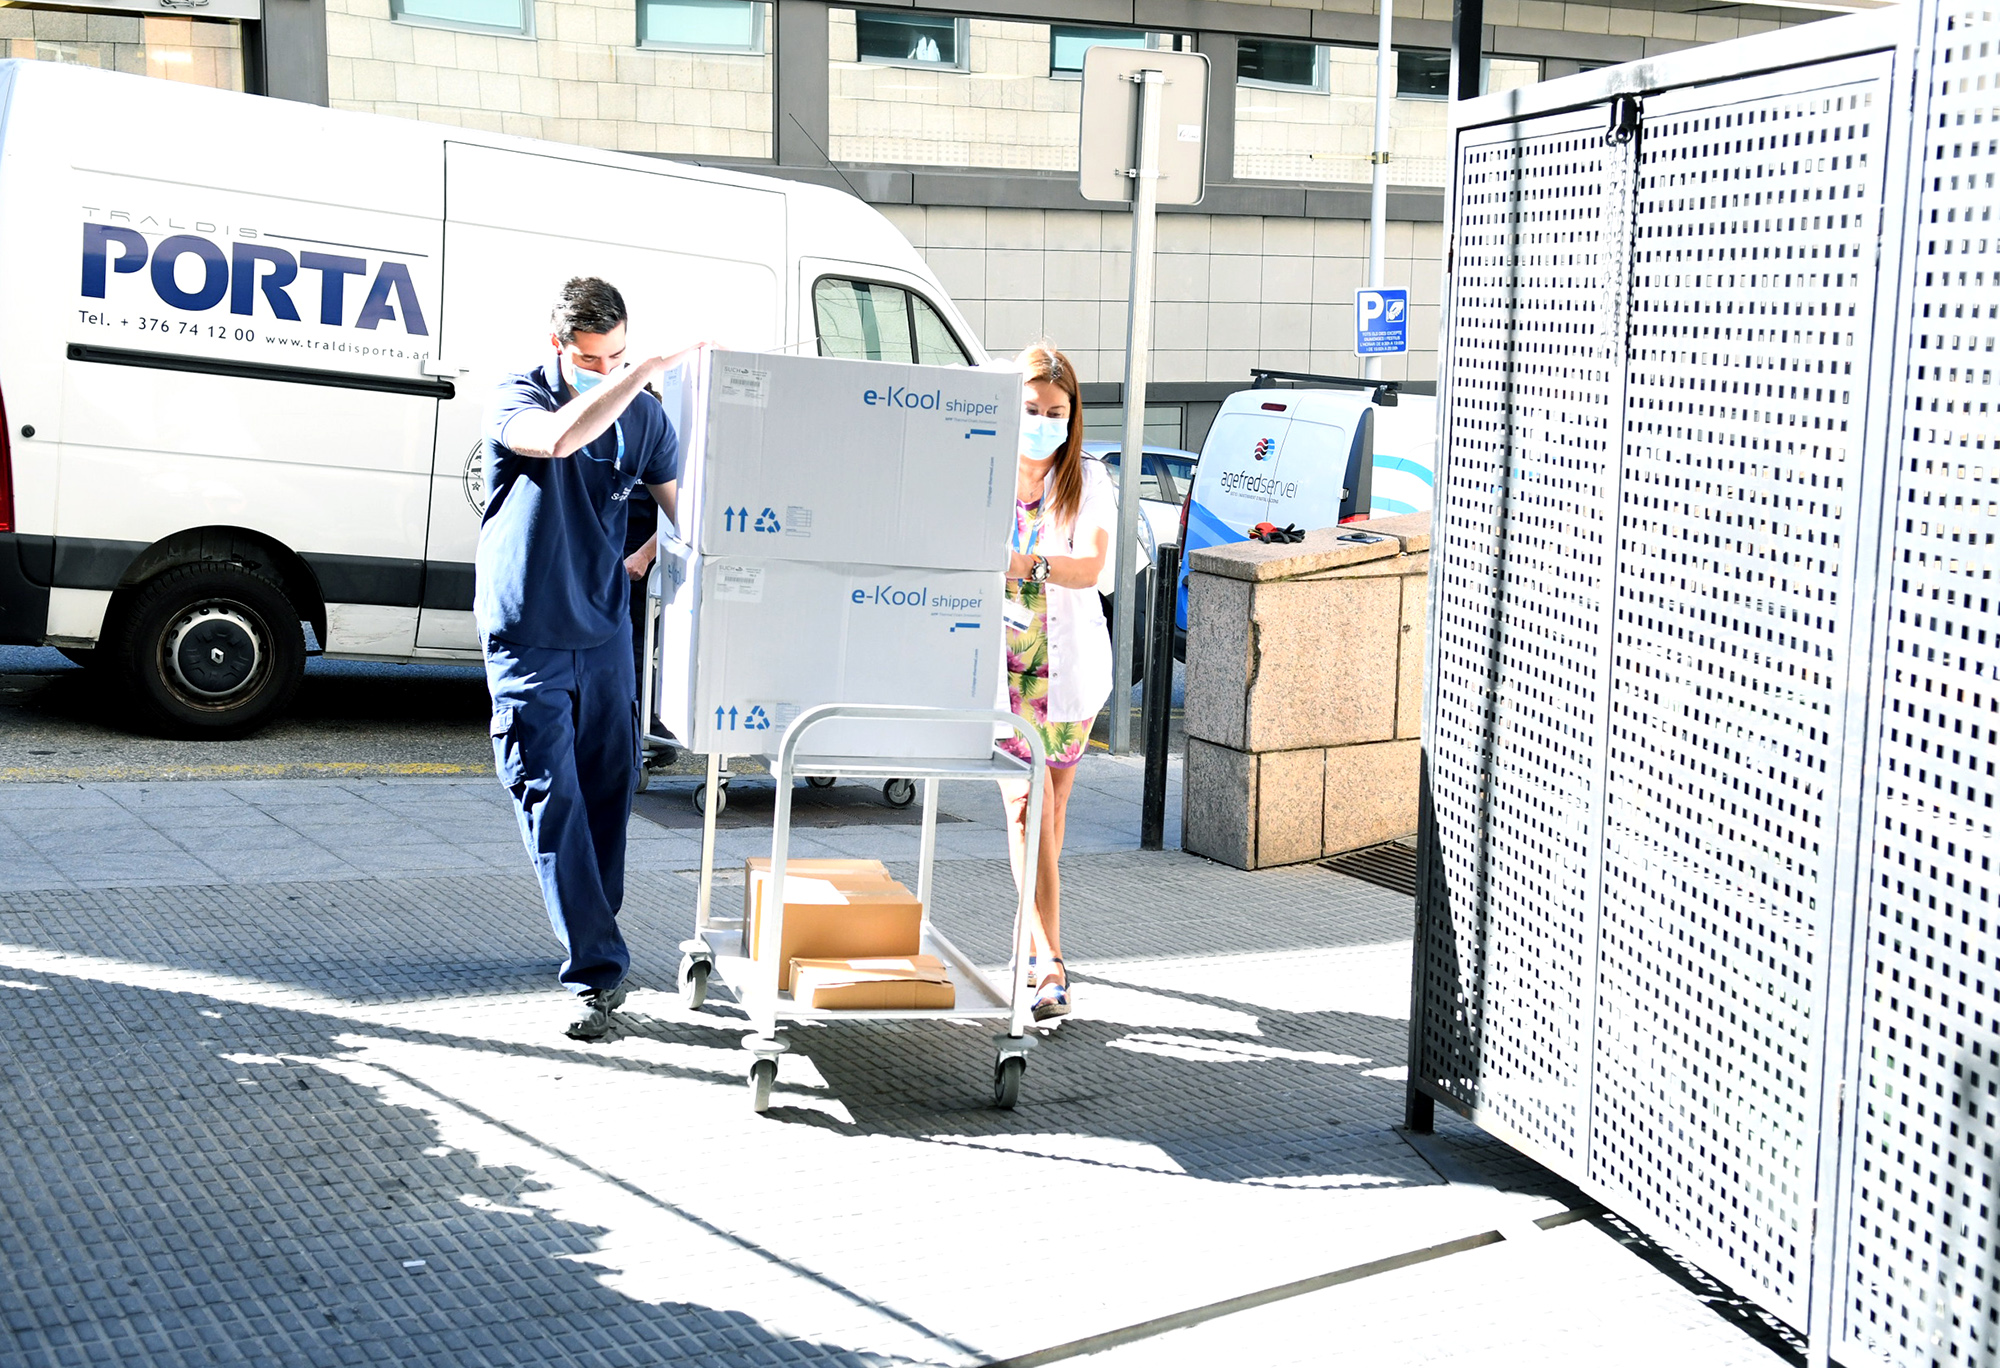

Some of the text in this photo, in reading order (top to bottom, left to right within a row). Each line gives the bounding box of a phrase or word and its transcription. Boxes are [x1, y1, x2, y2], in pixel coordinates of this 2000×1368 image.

[82, 206, 258, 239] TRALDIS
[81, 222, 429, 337] PORTA
[1360, 292, 1384, 331] P
[78, 310, 110, 326] Tel.
[138, 317, 170, 333] 376
[179, 321, 199, 336] 74
[208, 326, 227, 339] 12
[234, 328, 255, 342] 00
[265, 335, 429, 361] www.traldisporta.ad
[864, 386, 998, 416] e-Kool shipper
[1220, 470, 1299, 498] agefredservei
[851, 585, 983, 610] e-Kool shipper
